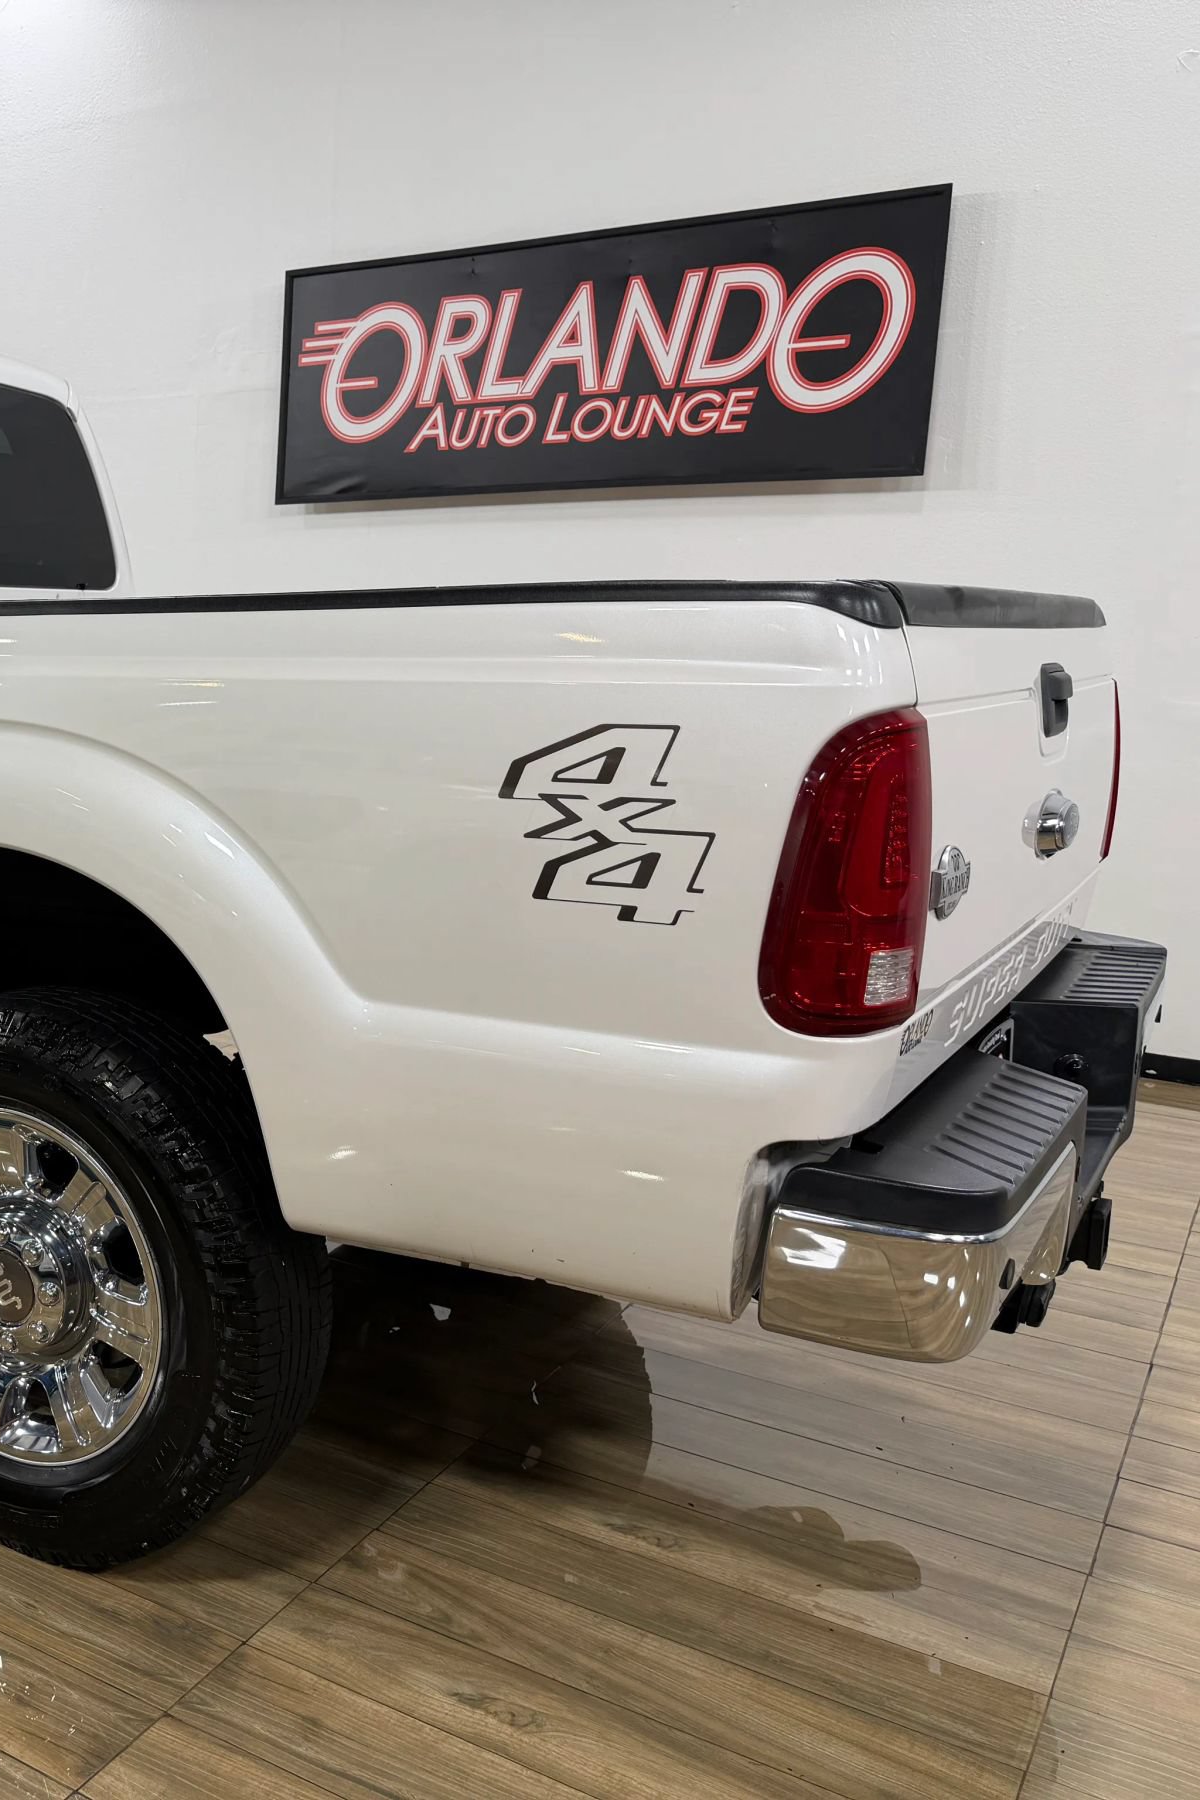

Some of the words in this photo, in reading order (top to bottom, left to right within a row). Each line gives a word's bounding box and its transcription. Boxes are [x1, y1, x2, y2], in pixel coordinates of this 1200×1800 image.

[299, 246, 917, 445] ORLANDO
[404, 402, 537, 453] AUTO
[542, 386, 759, 444] LOUNGE
[943, 943, 1029, 1048] SUPER
